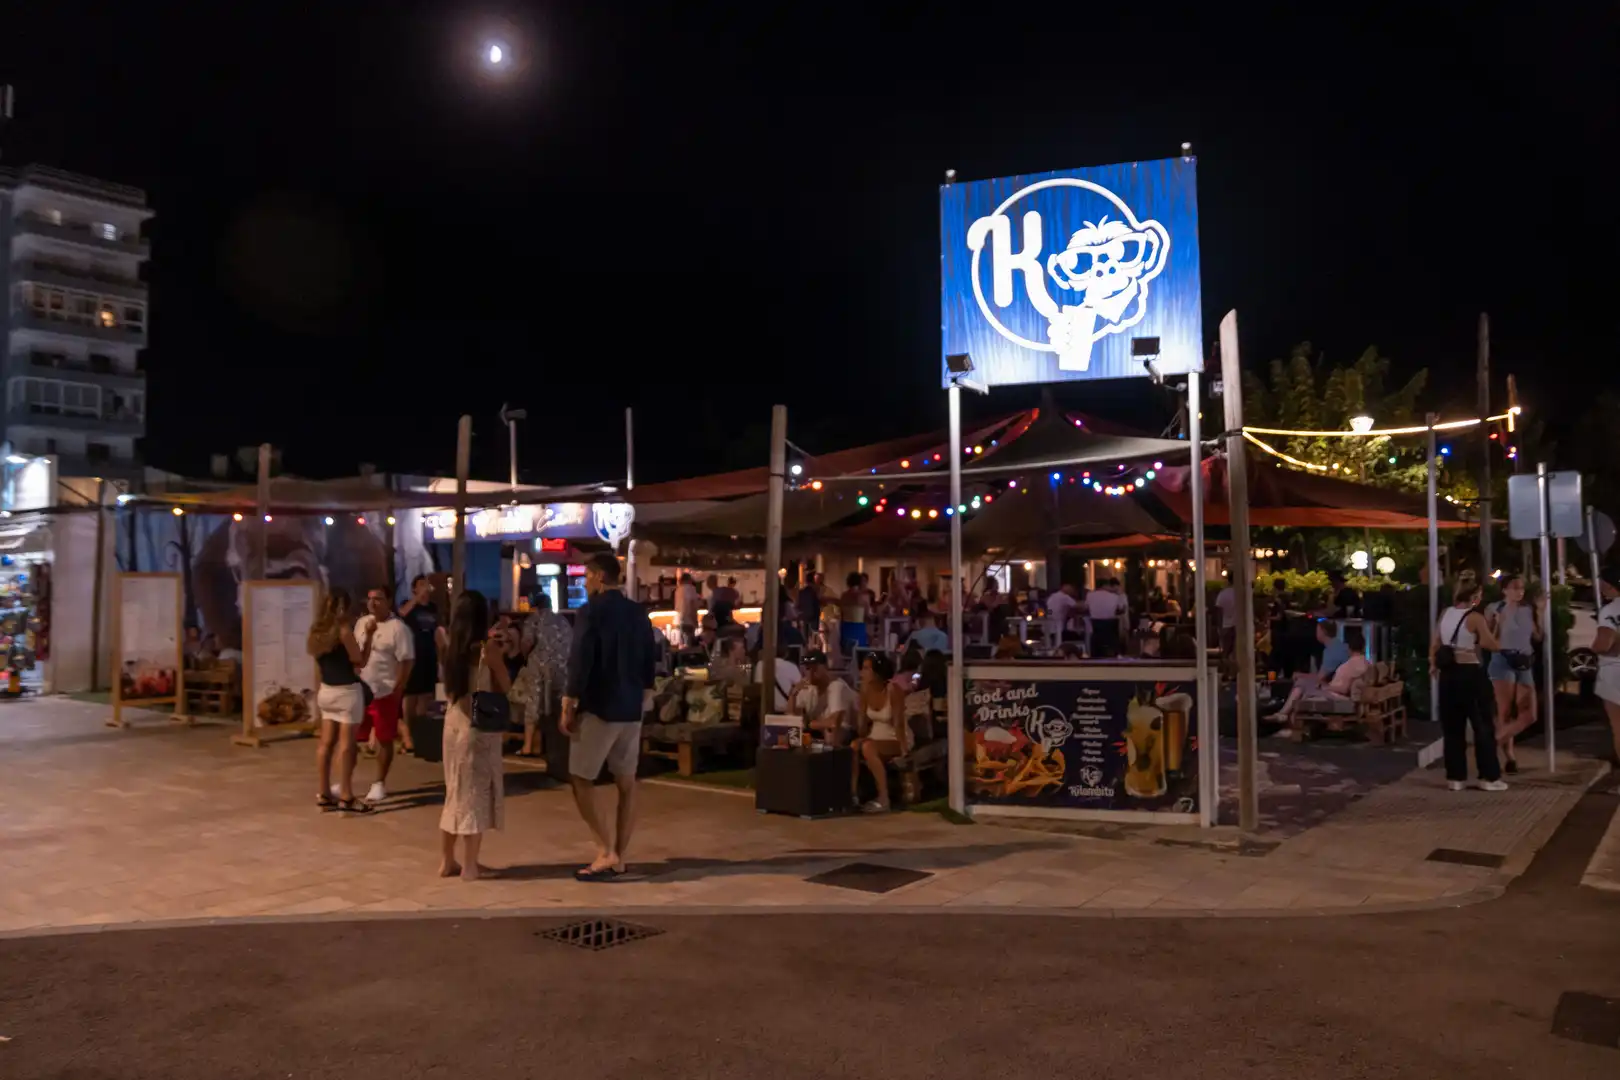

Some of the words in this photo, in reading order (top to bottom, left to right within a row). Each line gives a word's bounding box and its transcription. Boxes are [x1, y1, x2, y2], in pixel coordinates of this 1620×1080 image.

[967, 211, 1058, 318] K
[965, 688, 1003, 705] Food
[1006, 683, 1039, 700] and
[976, 702, 1030, 721] Drinks
